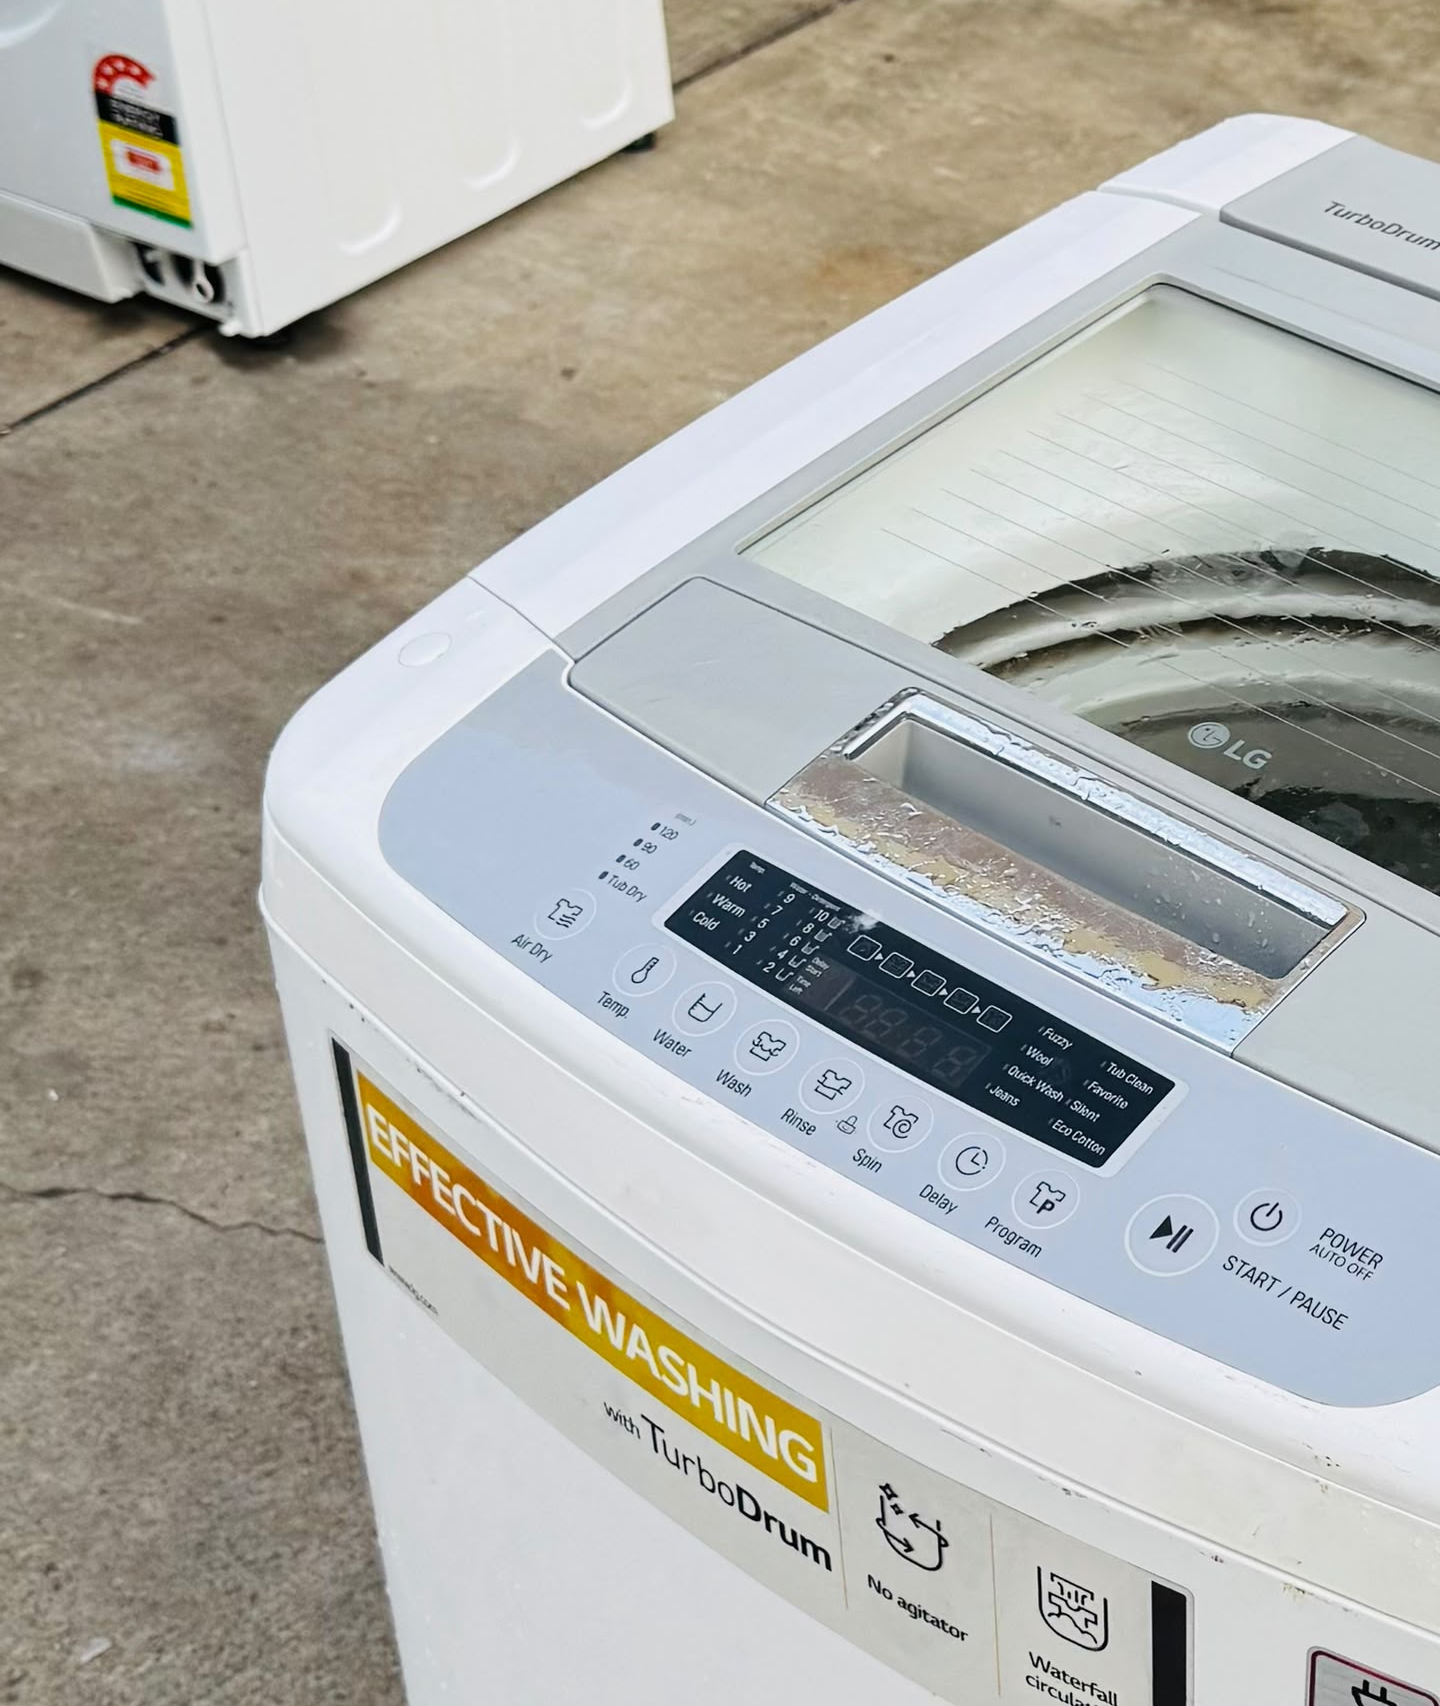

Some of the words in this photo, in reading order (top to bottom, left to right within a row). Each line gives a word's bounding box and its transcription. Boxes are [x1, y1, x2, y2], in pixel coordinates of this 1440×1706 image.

[1223, 739, 1272, 769] LG
[659, 825, 679, 841] 120
[624, 857, 640, 871] 60
[608, 874, 628, 893] Tub
[627, 884, 648, 903] Dry
[729, 876, 752, 893] Hot
[712, 893, 746, 918] Warm
[771, 905, 783, 917] 7
[783, 893, 796, 905] 9
[692, 911, 721, 932] Cold
[757, 919, 770, 930] 5
[802, 923, 814, 934] 8
[813, 909, 830, 923] 10
[511, 934, 534, 954] Air
[528, 942, 553, 964] Dry
[732, 944, 742, 955] 1
[744, 931, 757, 943] 3
[789, 935, 802, 947] 6
[776, 949, 789, 960] 4
[762, 962, 776, 974] 2
[597, 992, 629, 1020] Temp.
[653, 1029, 692, 1058] Water
[1042, 1027, 1073, 1051] Fuzzy
[1026, 1045, 1053, 1068] Wool
[716, 1069, 752, 1098] Wash
[1008, 1064, 1036, 1087] Quick
[1035, 1080, 1064, 1102] Wash
[1107, 1062, 1127, 1080] Tub
[1125, 1072, 1154, 1095] Clean
[989, 1084, 1021, 1107] Jeans
[1088, 1081, 1128, 1110] Favorite
[781, 1108, 817, 1136] Rinse
[1070, 1100, 1100, 1123] Silent
[1052, 1118, 1073, 1137] Eco
[1072, 1129, 1106, 1156] Cotton
[852, 1148, 883, 1174] Spin
[919, 1184, 959, 1215] Delay
[984, 1216, 1043, 1258] Program
[1319, 1227, 1384, 1270] POWER
[1309, 1243, 1345, 1268] AUTO
[1346, 1262, 1375, 1282] OFF
[366, 1102, 570, 1312] EFFECTIVE
[576, 1278, 818, 1483] WASHING
[1222, 1255, 1281, 1293] START
[1290, 1290, 1348, 1331] PAUSE
[603, 1401, 641, 1439] with
[641, 1413, 833, 1572] TurboDrum
[867, 1574, 893, 1600] No
[897, 1591, 968, 1641] agitator
